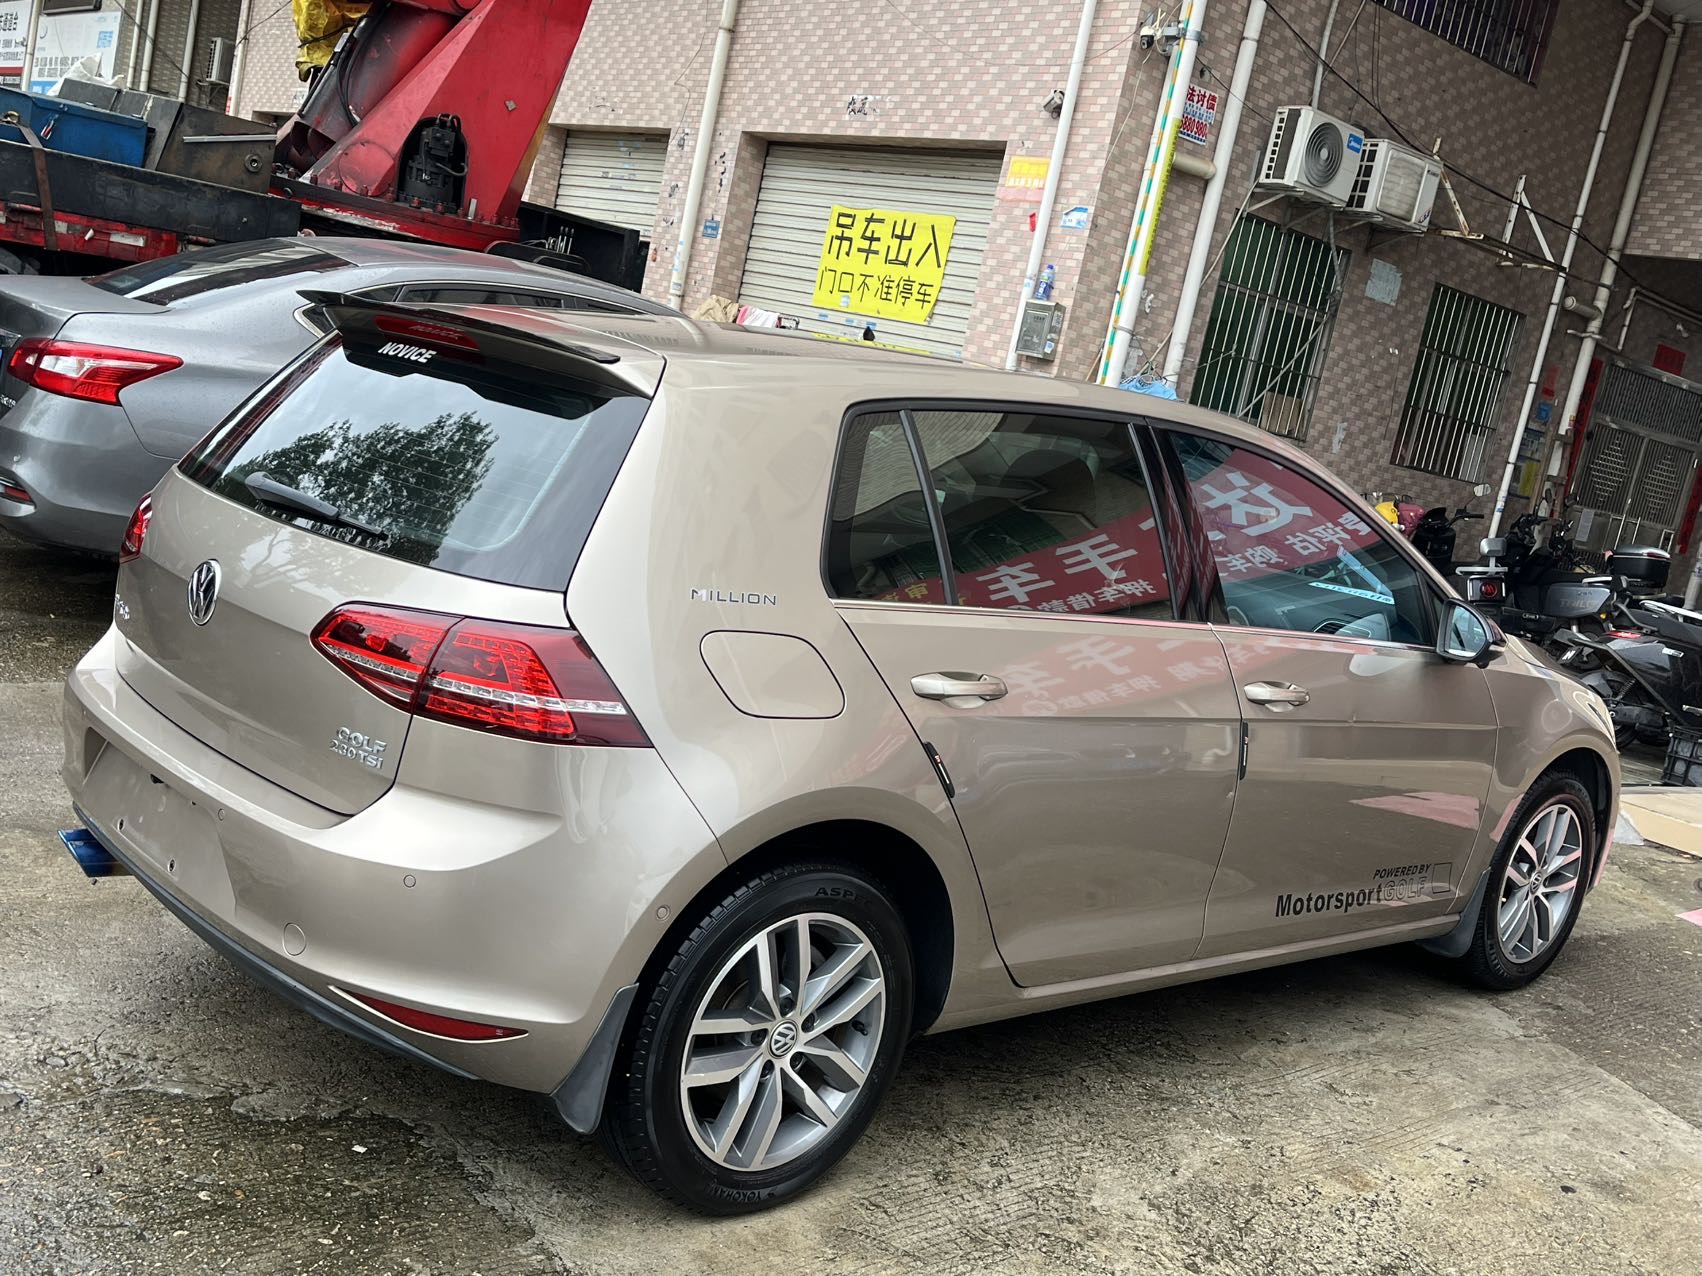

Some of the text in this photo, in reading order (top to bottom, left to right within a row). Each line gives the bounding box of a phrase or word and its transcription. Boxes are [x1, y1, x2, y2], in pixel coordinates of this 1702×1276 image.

[827, 212, 942, 269] 吊车出入
[818, 266, 934, 310] 门口不准停车
[377, 342, 438, 364] NOVICE
[690, 588, 777, 606] MILLION
[338, 727, 387, 753] GOLF
